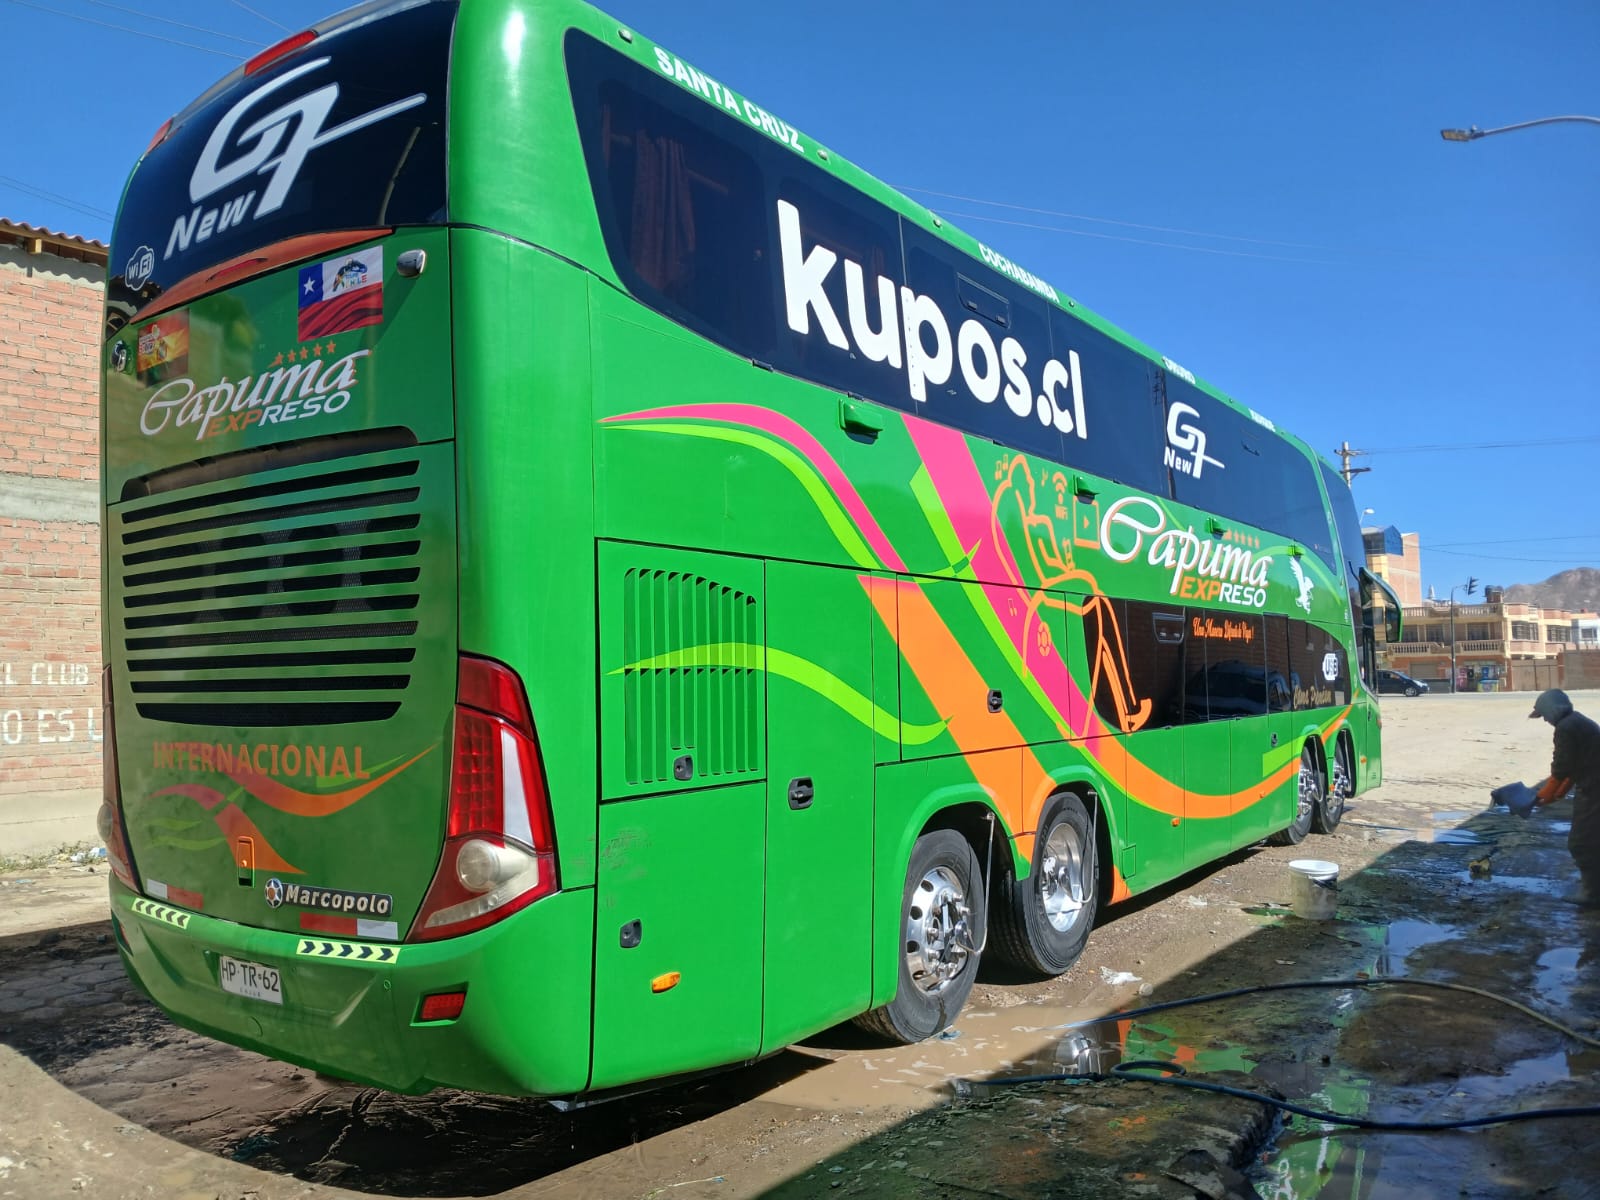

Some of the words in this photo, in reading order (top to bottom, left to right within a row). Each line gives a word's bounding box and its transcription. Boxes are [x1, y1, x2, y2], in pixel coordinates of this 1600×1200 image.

[653, 46, 741, 116] SANTA
[742, 99, 804, 153] CRUZ
[163, 191, 256, 261] New
[978, 242, 1060, 304] COCHABAMBA
[777, 199, 1087, 440] kupos.cl
[139, 348, 373, 441] Capuma
[206, 390, 351, 438] EXPRESO
[1163, 446, 1192, 475] New
[1100, 495, 1273, 595] Capuma
[1179, 576, 1267, 608] EXPRESO
[0, 662, 17, 685] L
[31, 662, 89, 685] CLUB
[38, 708, 75, 743] ES
[153, 741, 370, 780] INTERNACIONAL
[285, 884, 389, 915] Marcopolo
